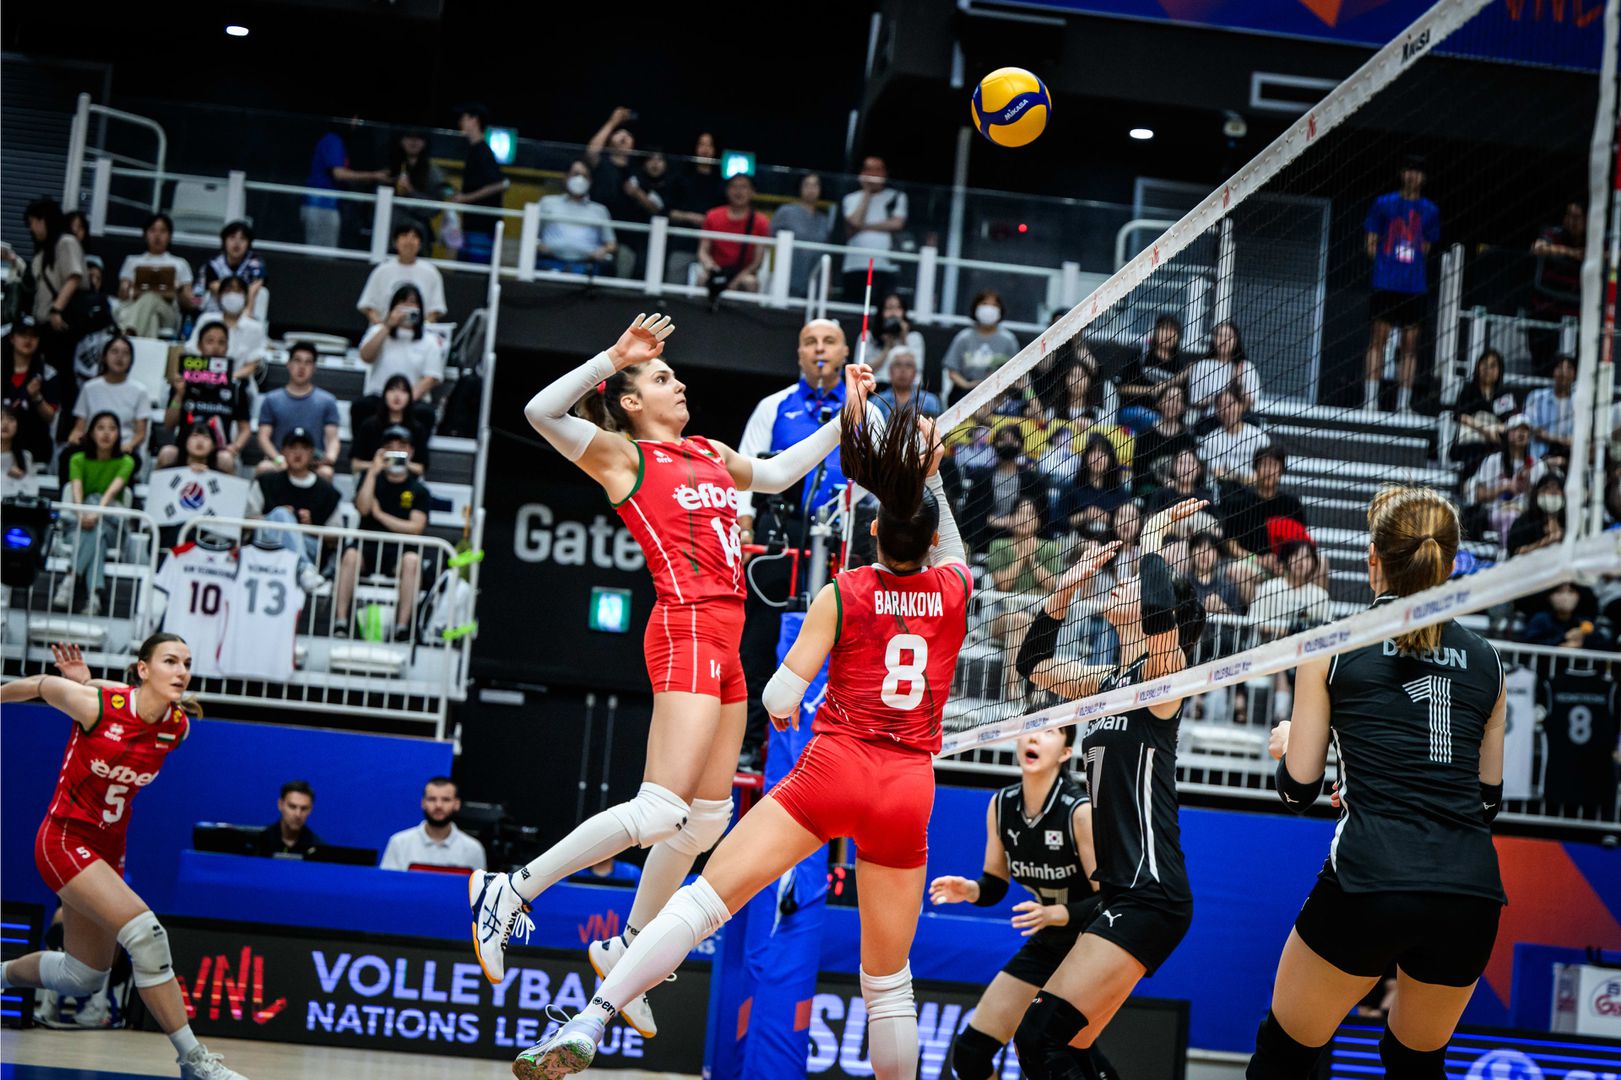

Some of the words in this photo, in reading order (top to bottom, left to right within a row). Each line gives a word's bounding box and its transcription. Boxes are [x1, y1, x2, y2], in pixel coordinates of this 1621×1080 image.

[183, 369, 229, 385] KOREA
[514, 502, 645, 571] Gate
[190, 581, 221, 616] 10
[244, 578, 286, 616] 13
[874, 590, 943, 617] BARAKOVA
[880, 633, 928, 711] 8
[1402, 675, 1452, 763] 1
[1569, 705, 1592, 745] 8
[102, 784, 129, 823] 5
[76, 846, 91, 859] 5
[1011, 860, 1077, 880] Shinhan
[311, 950, 606, 1013] VOLLEYBA
[306, 1000, 480, 1044] NATIONS
